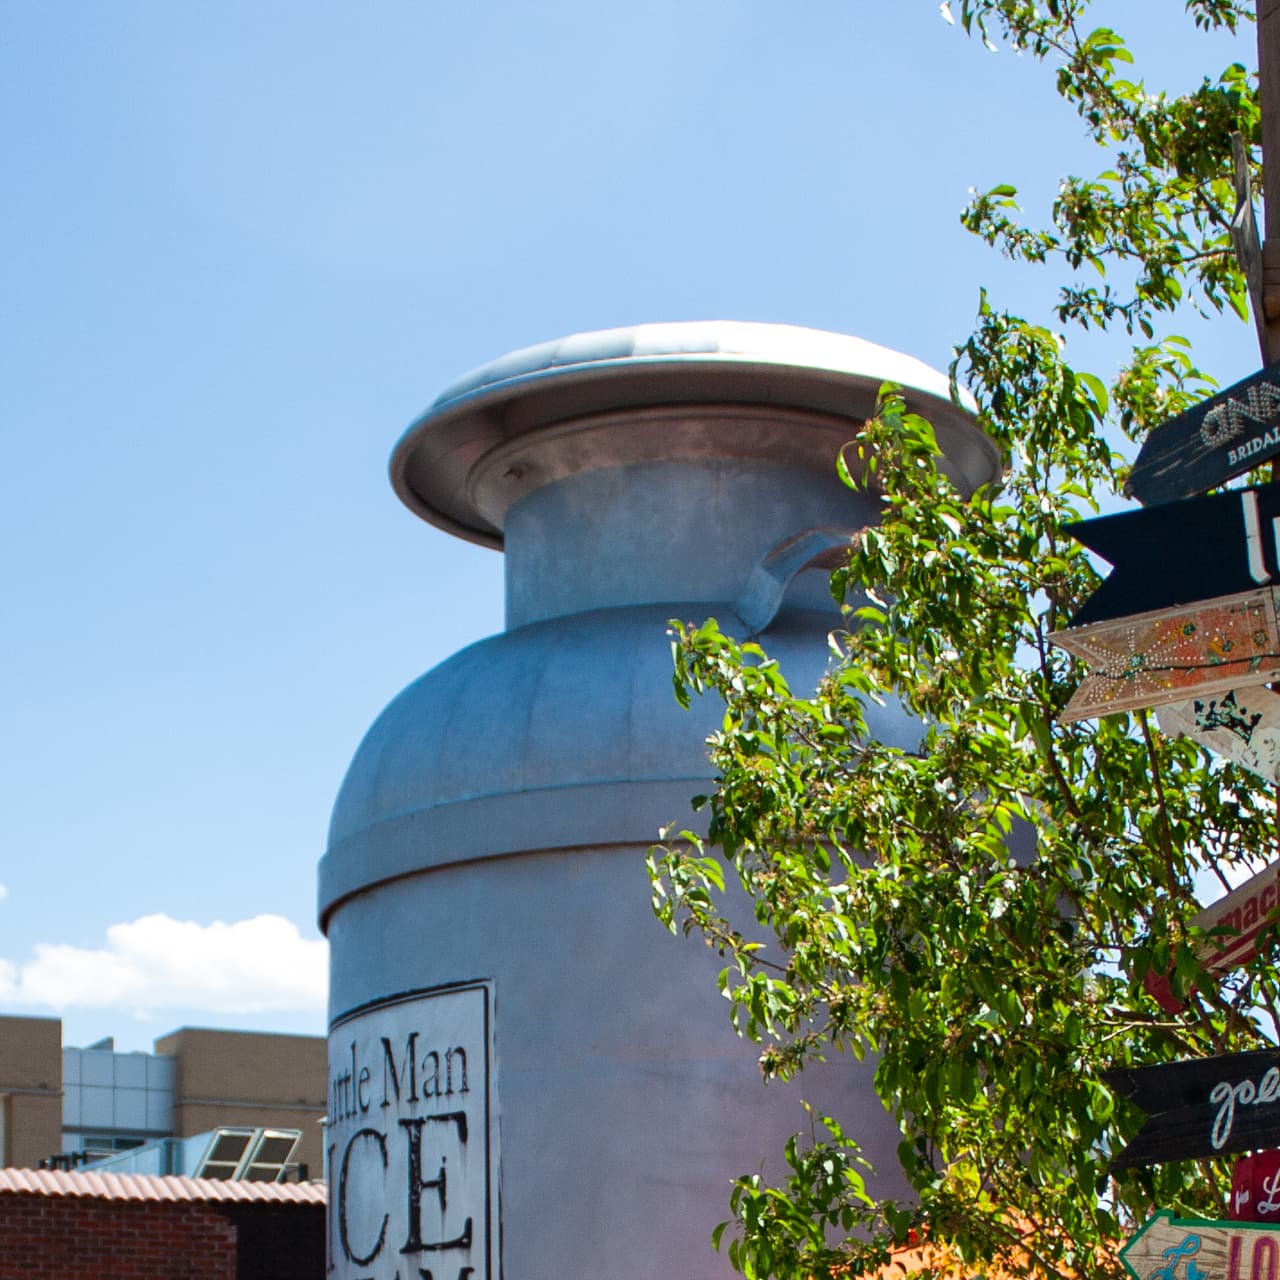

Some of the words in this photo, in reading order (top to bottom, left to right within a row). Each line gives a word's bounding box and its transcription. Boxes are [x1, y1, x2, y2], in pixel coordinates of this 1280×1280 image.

[328, 1040, 370, 1128] ittle
[380, 1031, 470, 1108] Man
[328, 1110, 473, 1271] ICE
